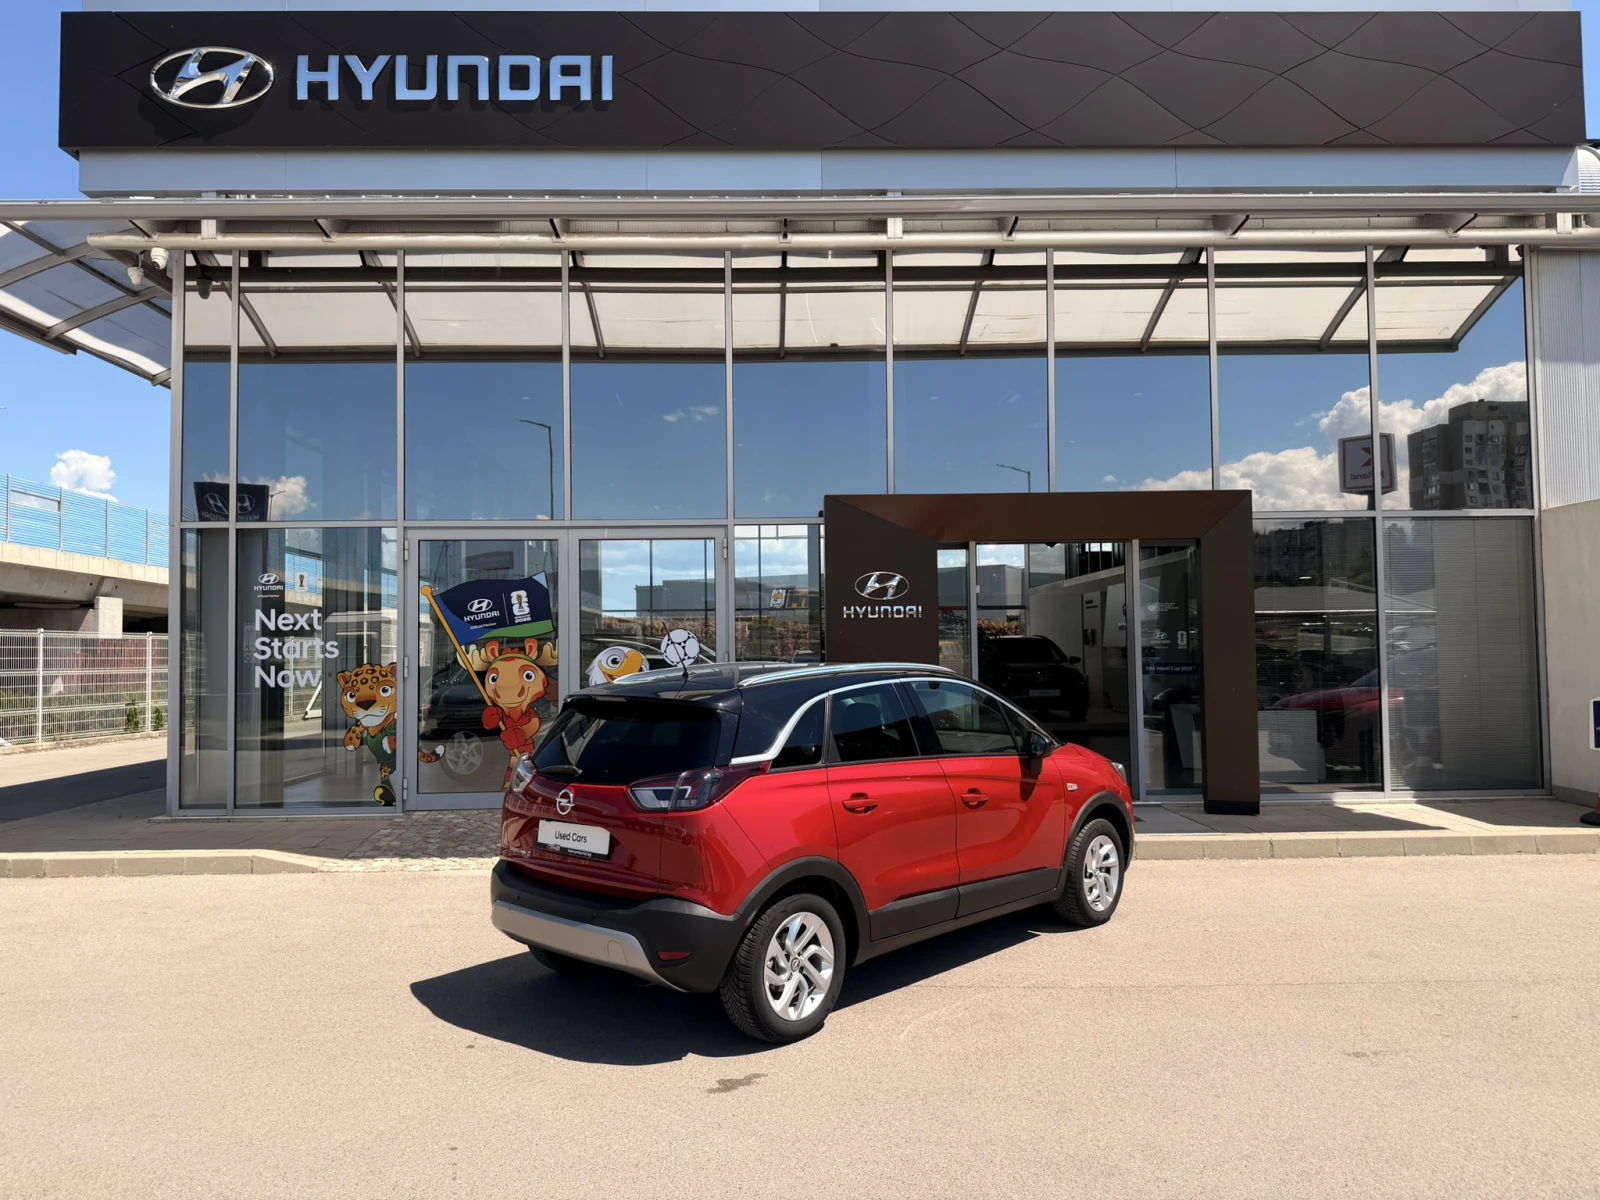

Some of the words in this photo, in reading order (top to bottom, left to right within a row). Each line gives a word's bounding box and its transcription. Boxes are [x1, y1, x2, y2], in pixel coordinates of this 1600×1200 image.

[296, 55, 613, 101] HYUNDAI
[255, 608, 322, 631] Next
[464, 610, 500, 622] HYUNDAI
[843, 606, 922, 619] HYUNDAI
[253, 636, 340, 660] Starts
[254, 665, 322, 688] Now
[554, 830, 571, 841] Used
[571, 832, 588, 843] Cars
